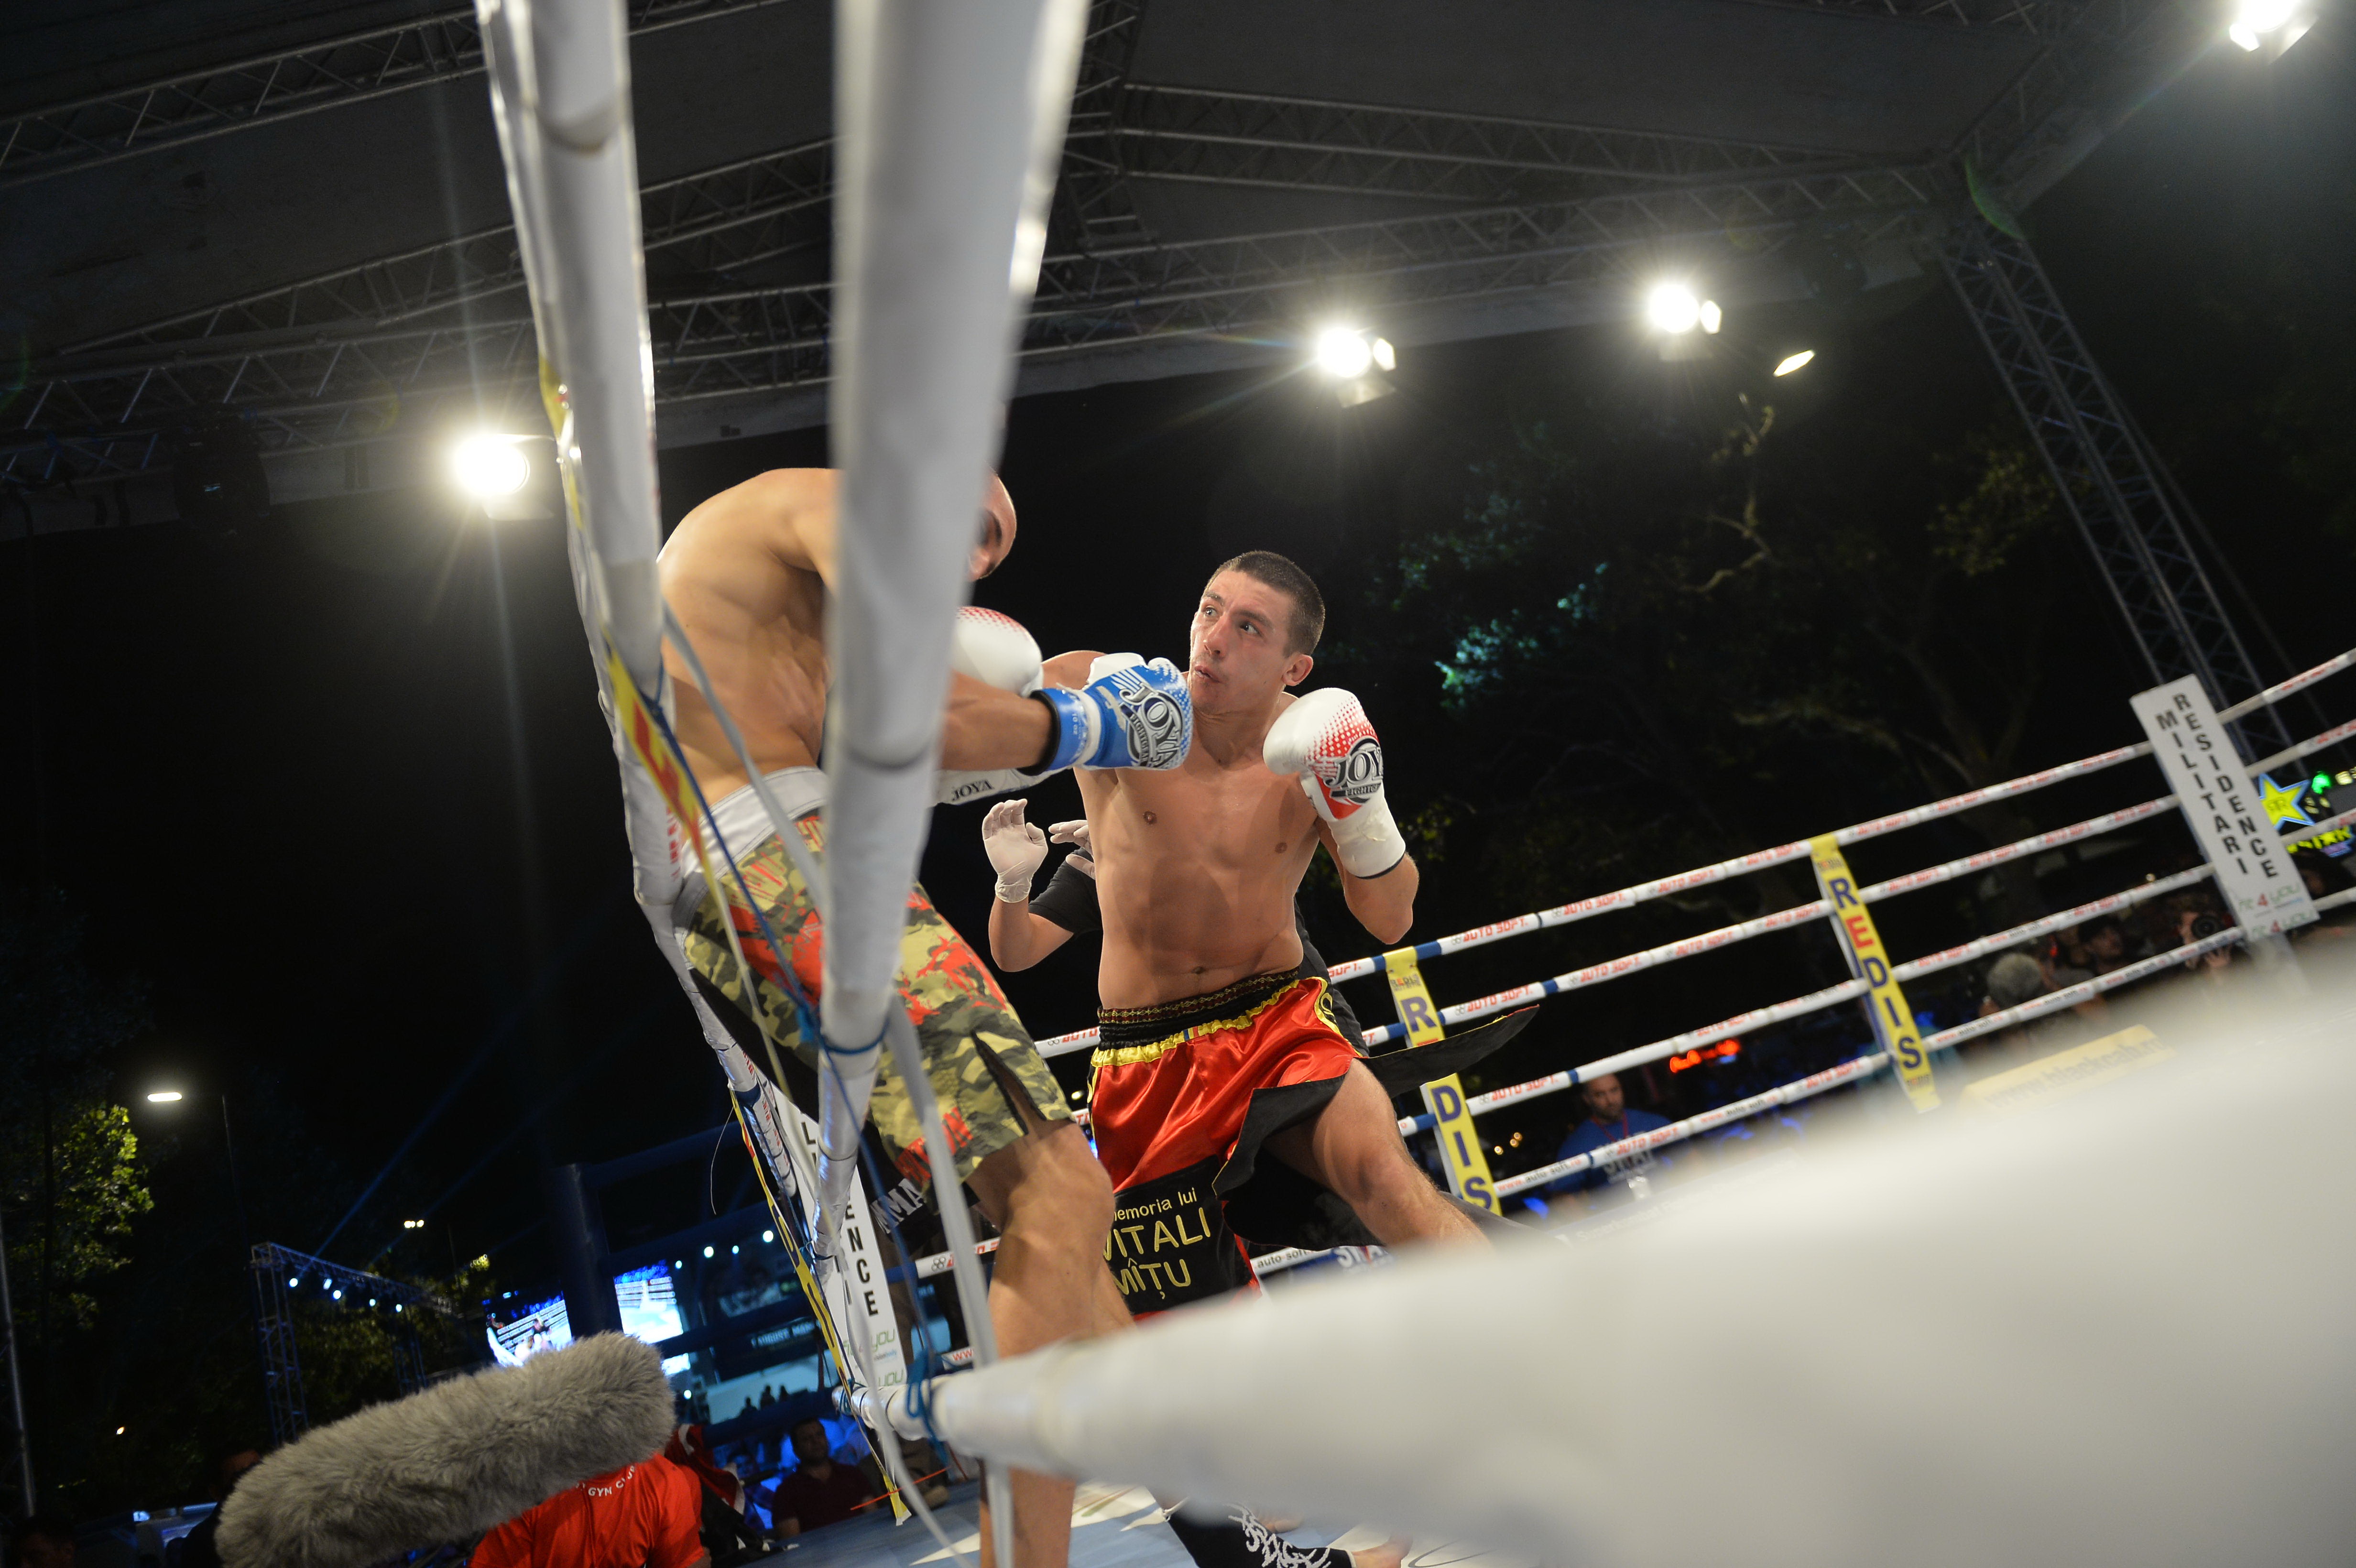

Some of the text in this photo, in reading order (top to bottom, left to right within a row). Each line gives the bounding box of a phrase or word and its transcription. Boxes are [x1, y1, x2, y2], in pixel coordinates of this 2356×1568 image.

[1323, 747, 1383, 788] JOY
[951, 780, 994, 801] JOYA
[2156, 709, 2248, 874] MILITARI
[2173, 693, 2278, 878] RESIDENCE
[1658, 877, 1685, 893] AUTO
[1563, 899, 1592, 916] AUTO
[1463, 917, 1529, 942] AUTO SOFT.
[1676, 939, 1703, 956] AUTO
[1580, 965, 1609, 982] AUTO
[1829, 878, 1921, 1068] REDIS
[1467, 985, 1533, 1013] AUTO SOFT.
[1062, 1026, 1098, 1043] AUTO
[1491, 1076, 1559, 1102] AUTO SOFT.
[1400, 996, 1492, 1211] RDIS
[1617, 1137, 1647, 1155] AUTO
[1114, 1187, 1197, 1221] emoria lui
[1102, 1207, 1211, 1261] VITALI
[588, 1486, 612, 1497] GYM
